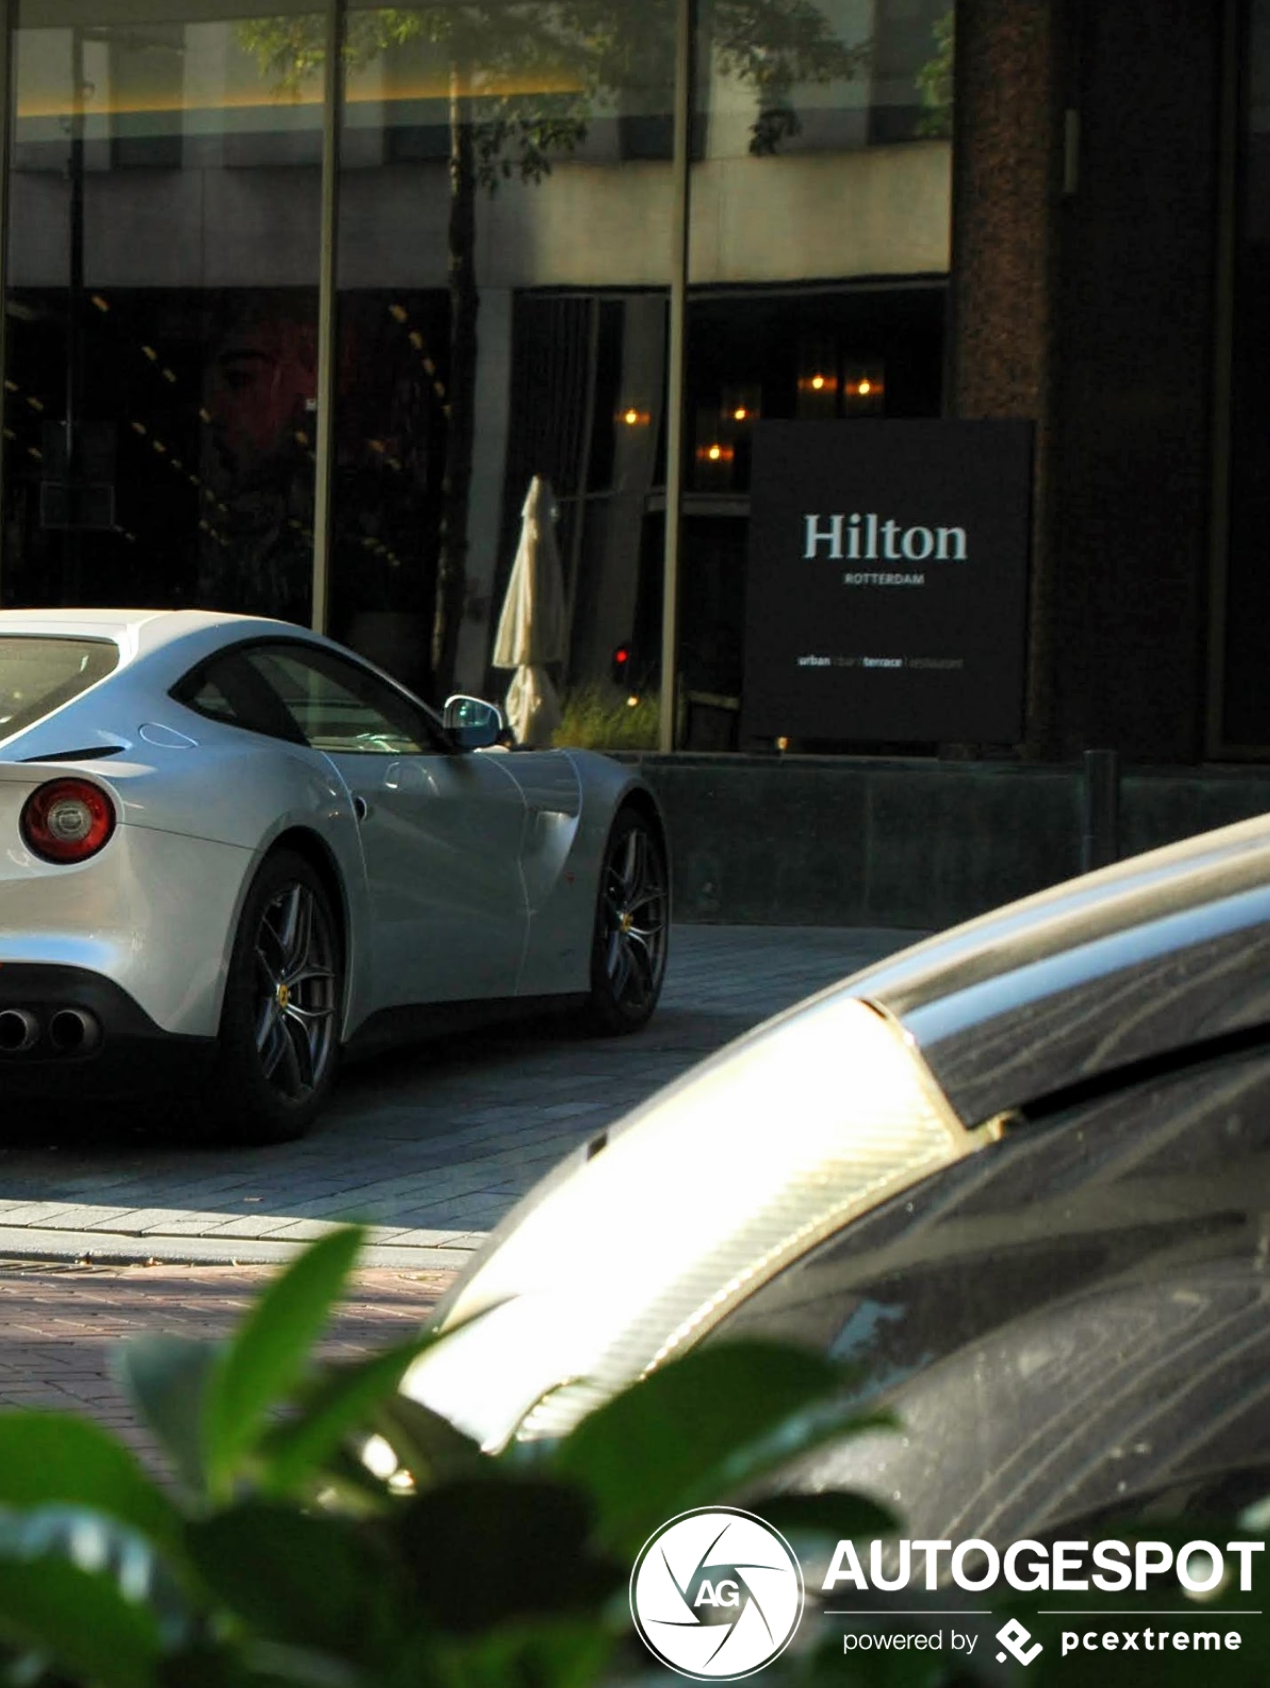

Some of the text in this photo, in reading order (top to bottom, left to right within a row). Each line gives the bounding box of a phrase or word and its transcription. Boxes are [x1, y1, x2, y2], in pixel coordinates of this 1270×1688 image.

[803, 513, 968, 560] Hilton
[844, 572, 925, 585] ROTTERDAM
[798, 656, 831, 668] urban
[863, 656, 902, 668] terrace
